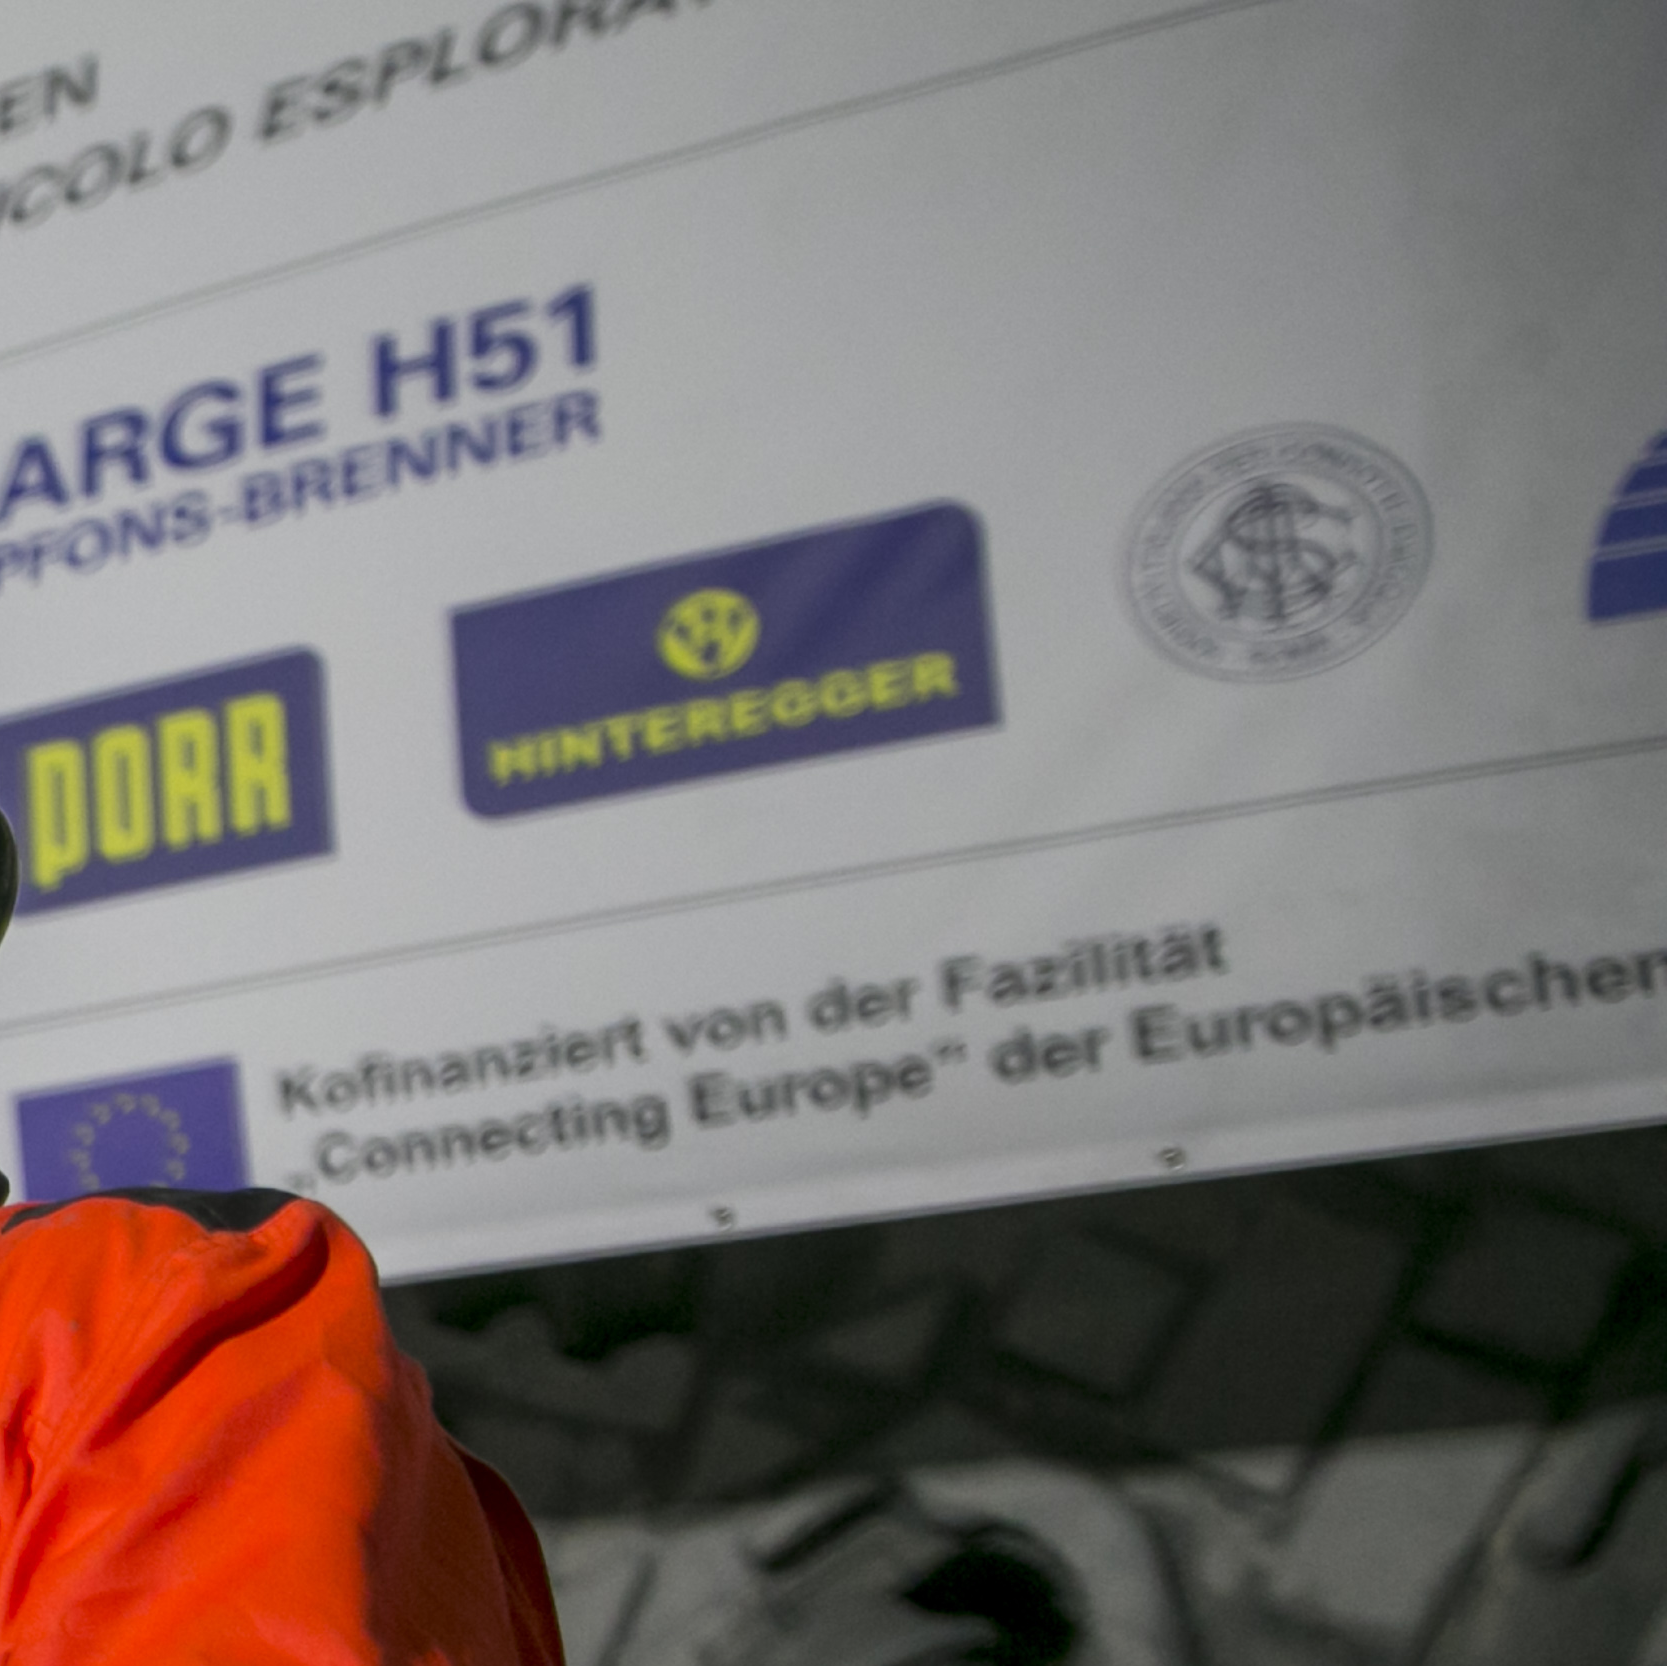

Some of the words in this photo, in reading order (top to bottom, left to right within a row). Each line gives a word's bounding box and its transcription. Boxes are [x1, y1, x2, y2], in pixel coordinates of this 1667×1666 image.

[369, 280, 599, 420] H51
[488, 652, 958, 788] HINTEREGGER
[25, 692, 291, 891] PORR
[276, 1013, 650, 1120] Kofinanziert
[669, 996, 787, 1053] von
[805, 974, 920, 1035] der
[940, 920, 1229, 1008] Fazilität
[987, 1022, 1110, 1086] der
